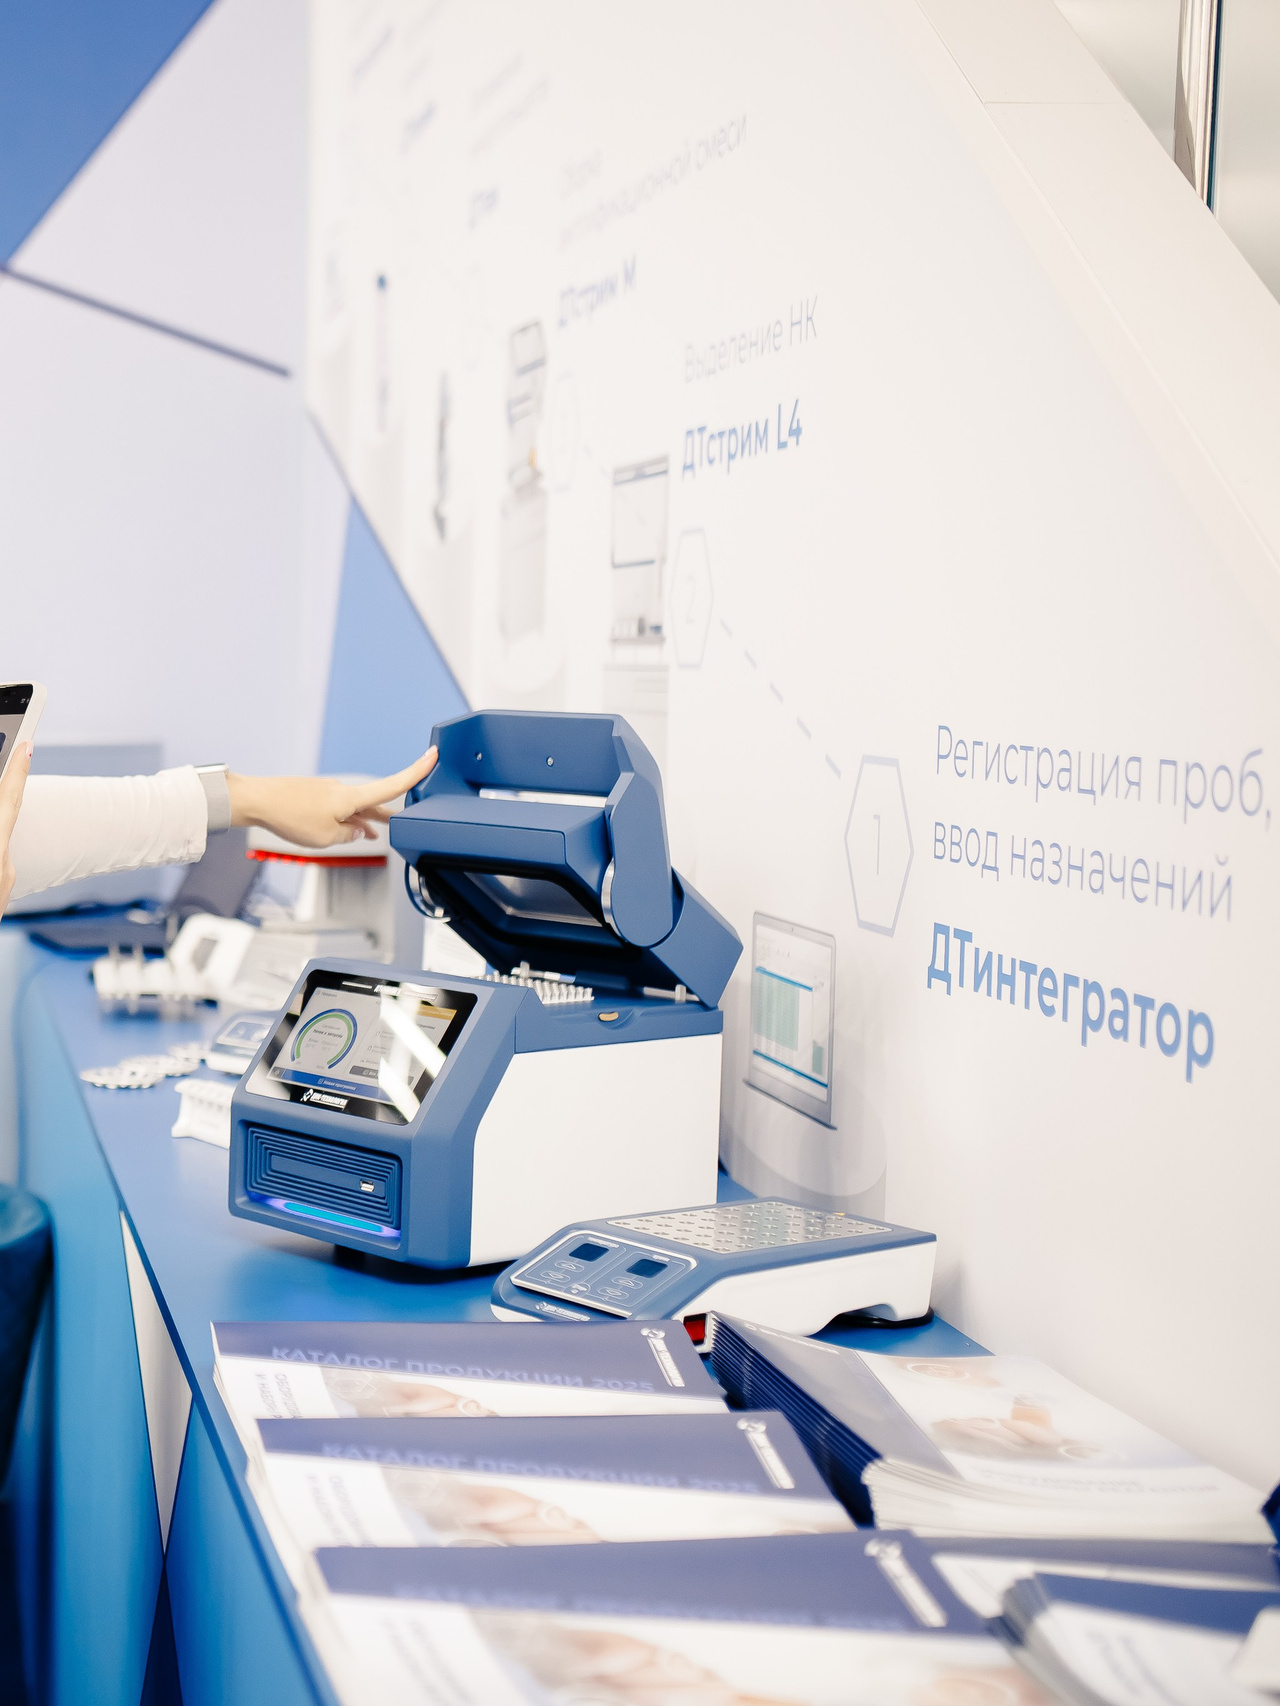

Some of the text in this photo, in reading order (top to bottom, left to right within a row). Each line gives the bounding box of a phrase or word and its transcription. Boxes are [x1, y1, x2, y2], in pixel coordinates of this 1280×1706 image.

[685, 295, 818, 383] Выделение НК
[682, 398, 802, 482] ДТстрим L4
[935, 724, 1272, 833] Регистрация проб,
[933, 821, 1233, 922] ввод назначений
[927, 922, 1215, 1084] ДТинтегратор
[271, 1346, 655, 1393] КАТАЛОГ ПРОДУКЦИИ 2025
[322, 1444, 468, 1471] КАТАЛОГ
